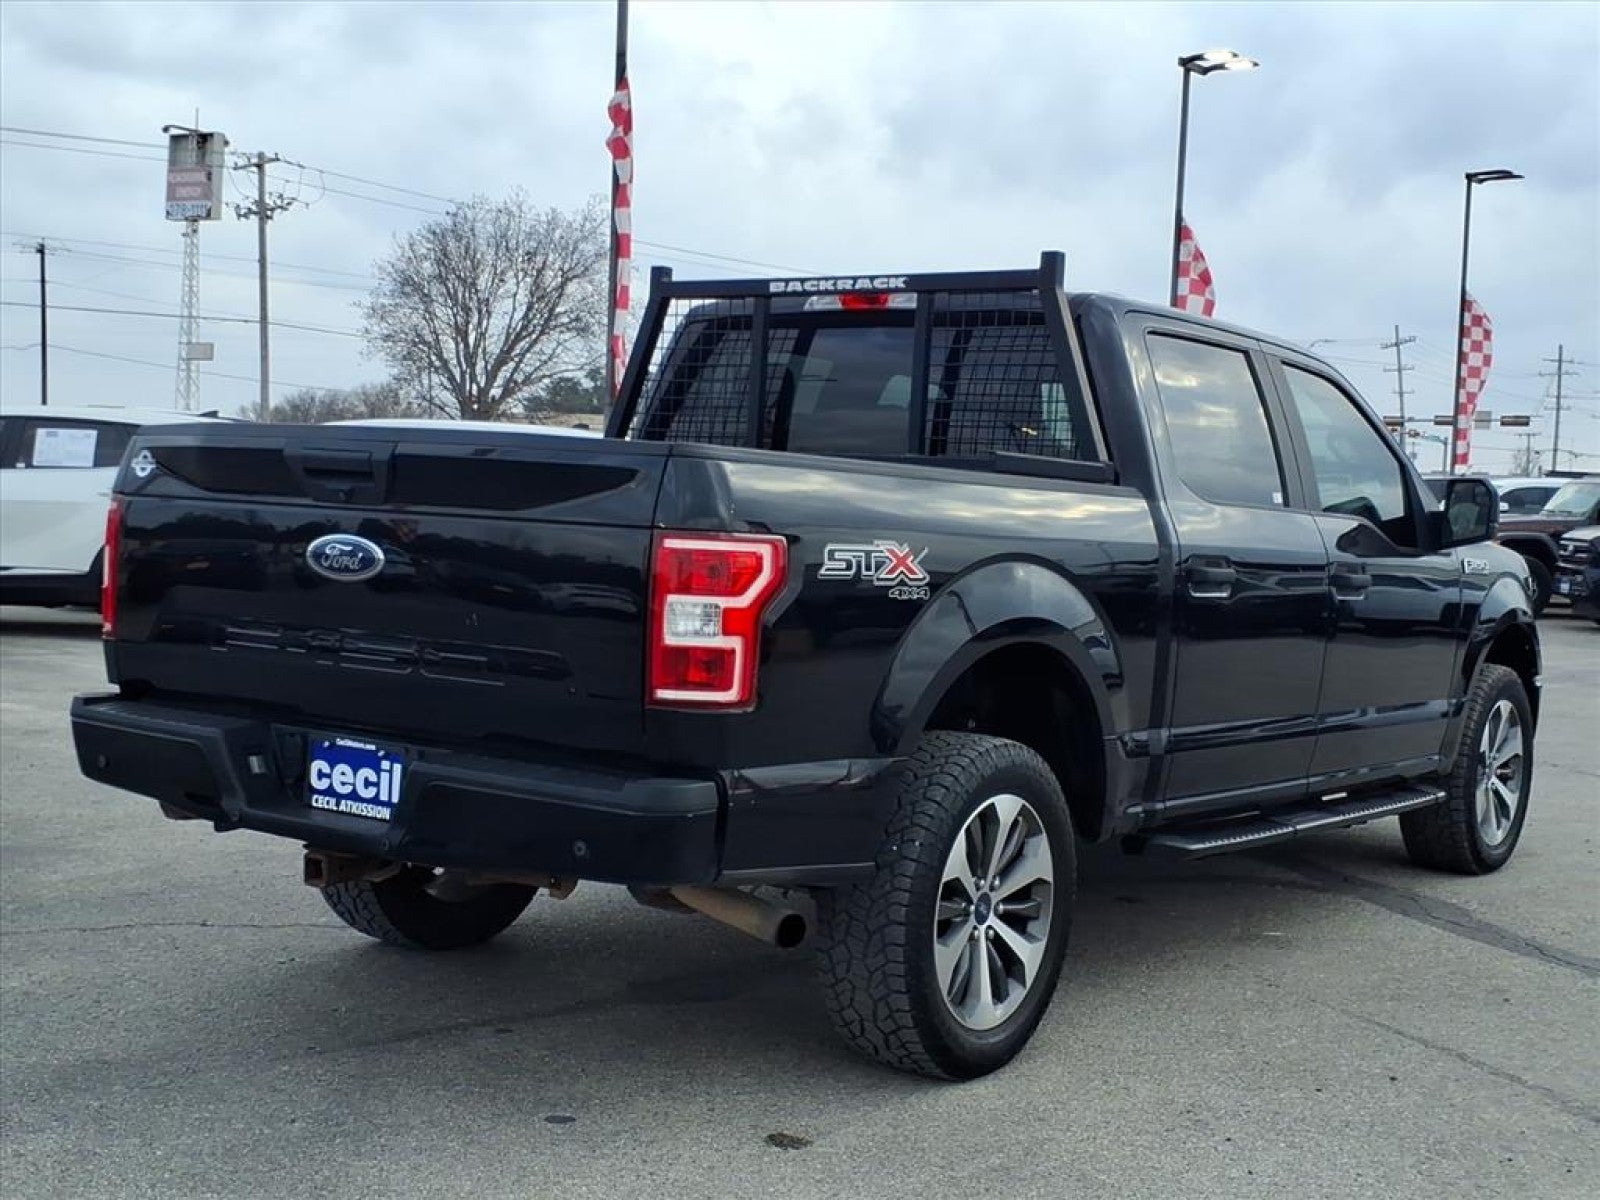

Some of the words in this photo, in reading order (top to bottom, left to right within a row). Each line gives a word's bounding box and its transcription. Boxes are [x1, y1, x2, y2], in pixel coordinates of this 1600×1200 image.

[769, 276, 908, 293] BACKRACK
[322, 542, 364, 571] Ford
[817, 539, 929, 586] STX
[310, 759, 402, 804] cecil
[311, 794, 338, 810] CECIL
[339, 799, 391, 820] ATKISSION
